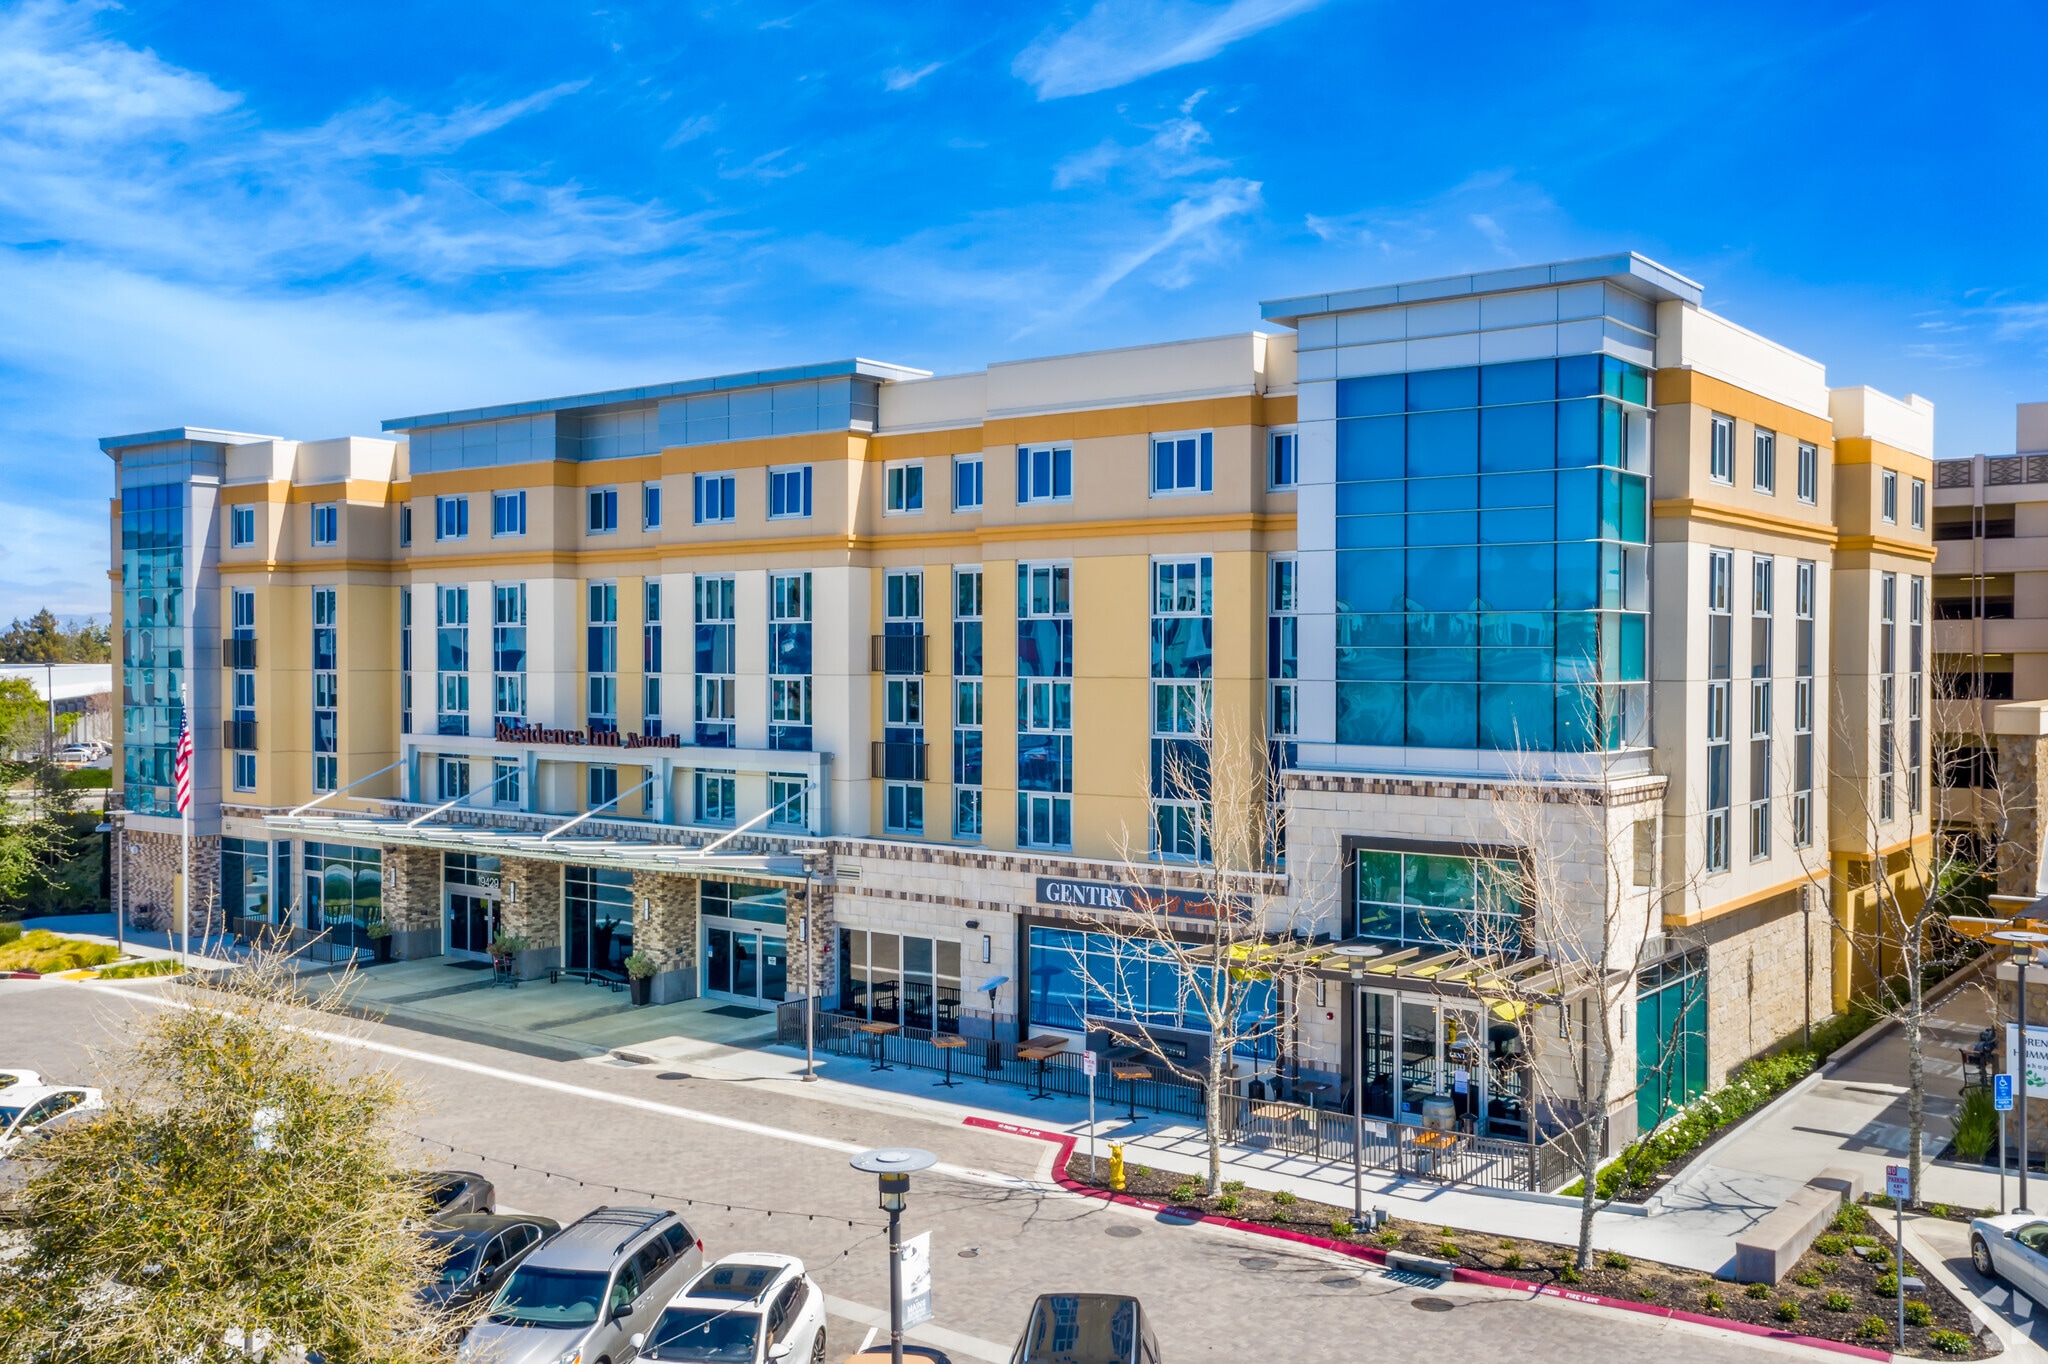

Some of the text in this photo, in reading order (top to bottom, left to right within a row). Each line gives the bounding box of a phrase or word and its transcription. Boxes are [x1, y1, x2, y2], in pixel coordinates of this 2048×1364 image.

[495, 722, 681, 749] Residence Inn Marriott
[478, 876, 499, 889] 19429
[1046, 882, 1125, 908] GENTRY
[2025, 1038, 2048, 1048] REN
[1887, 1166, 1896, 1175] NO
[1888, 1176, 1908, 1185] PARKING
[1565, 1292, 1582, 1301] FIRE
[1582, 1296, 1600, 1304] LANE
